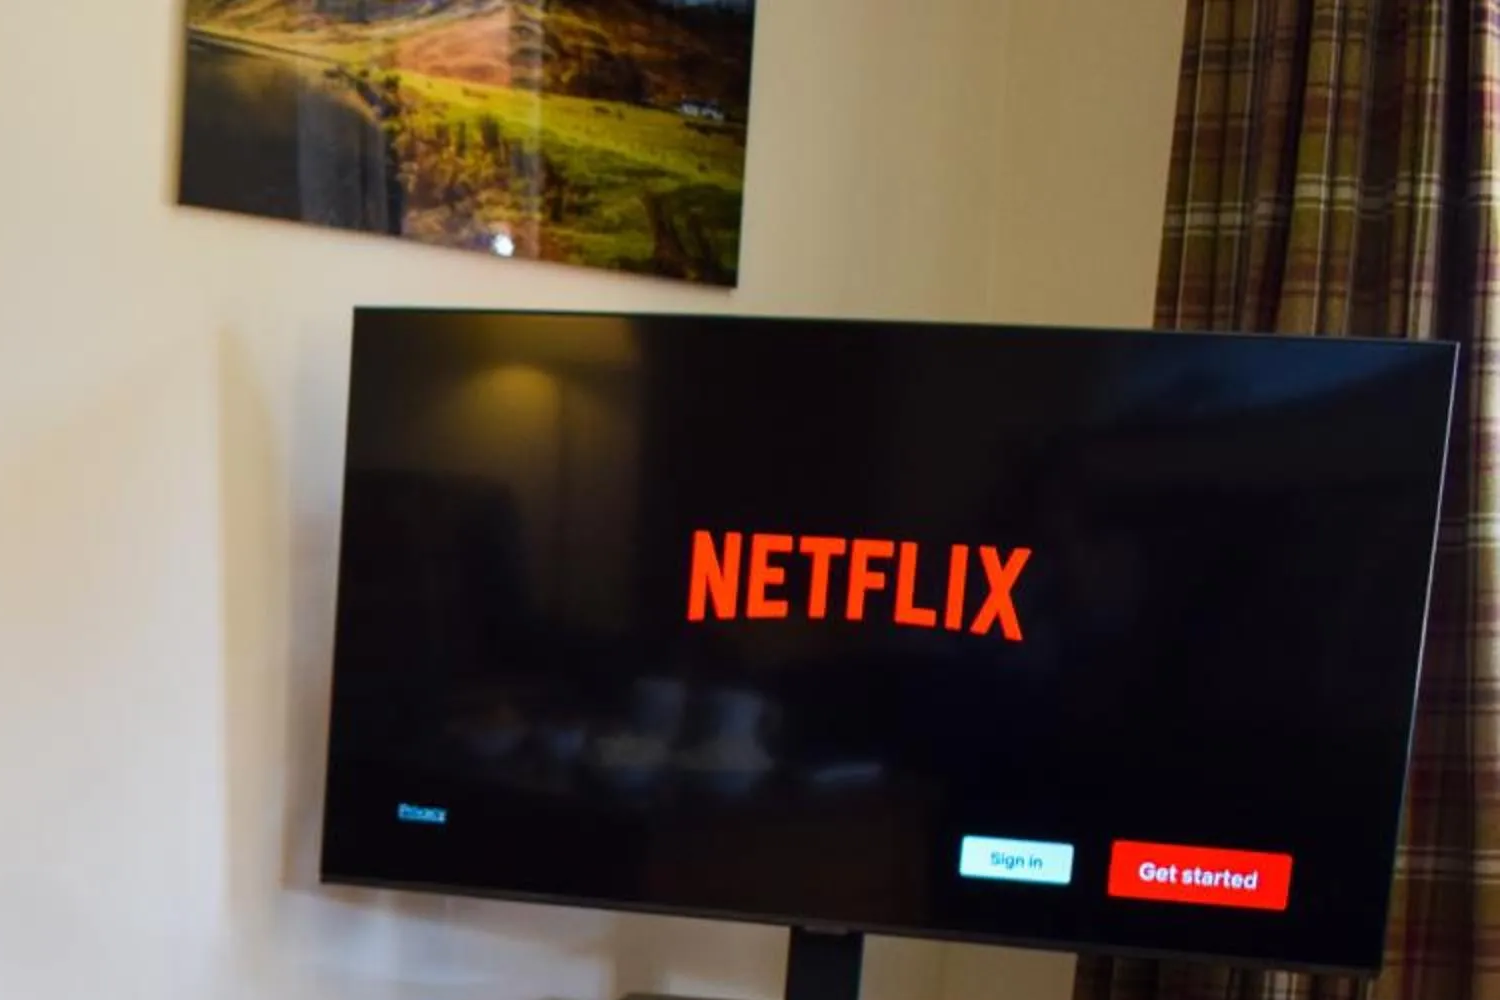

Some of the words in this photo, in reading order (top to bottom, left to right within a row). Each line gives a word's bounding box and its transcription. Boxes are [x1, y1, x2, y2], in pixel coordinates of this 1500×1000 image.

[687, 530, 1032, 641] NETFLIX
[990, 851, 1025, 870] Sign
[1029, 854, 1043, 869] in
[1139, 861, 1176, 884] Get
[1182, 867, 1258, 891] started
